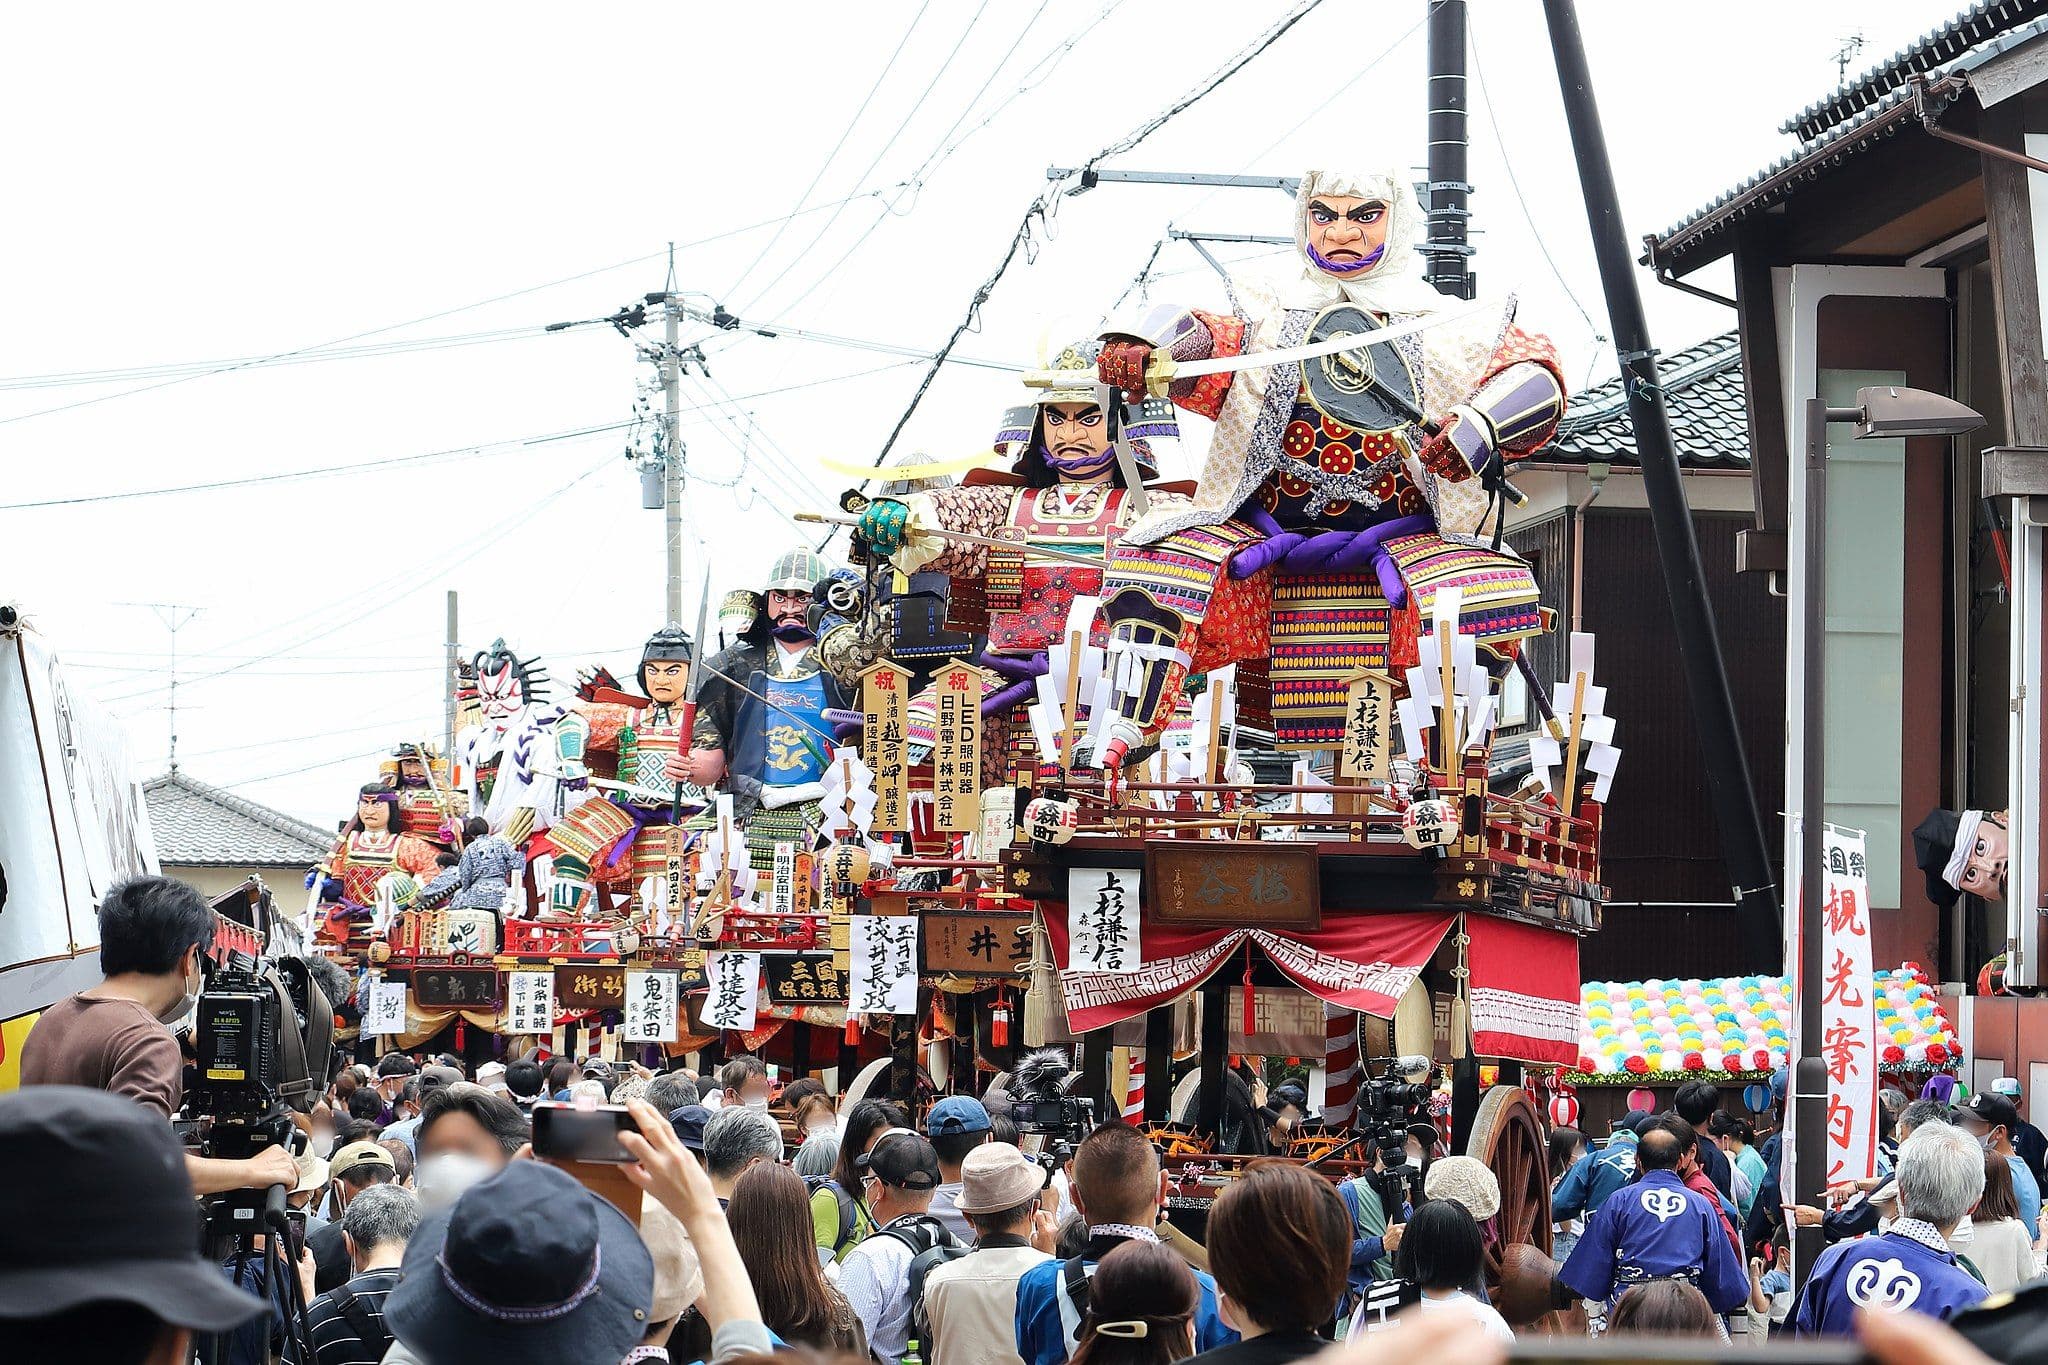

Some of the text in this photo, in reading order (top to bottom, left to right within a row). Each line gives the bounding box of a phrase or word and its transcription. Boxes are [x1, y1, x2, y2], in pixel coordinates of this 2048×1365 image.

[874, 671, 896, 691] 祝
[947, 671, 970, 691] 祝
[958, 692, 975, 795] LED照明器
[1350, 680, 1382, 772] 上杉謙信
[937, 695, 956, 827] 日野電子株式会社
[1034, 802, 1060, 843] 森町
[1415, 801, 1443, 844] 森町
[775, 855, 790, 913] 明治安田生命
[1091, 871, 1130, 971] 上杉謙信
[642, 974, 663, 1038] 鬼柴田
[711, 952, 750, 1028] 伊達政宗
